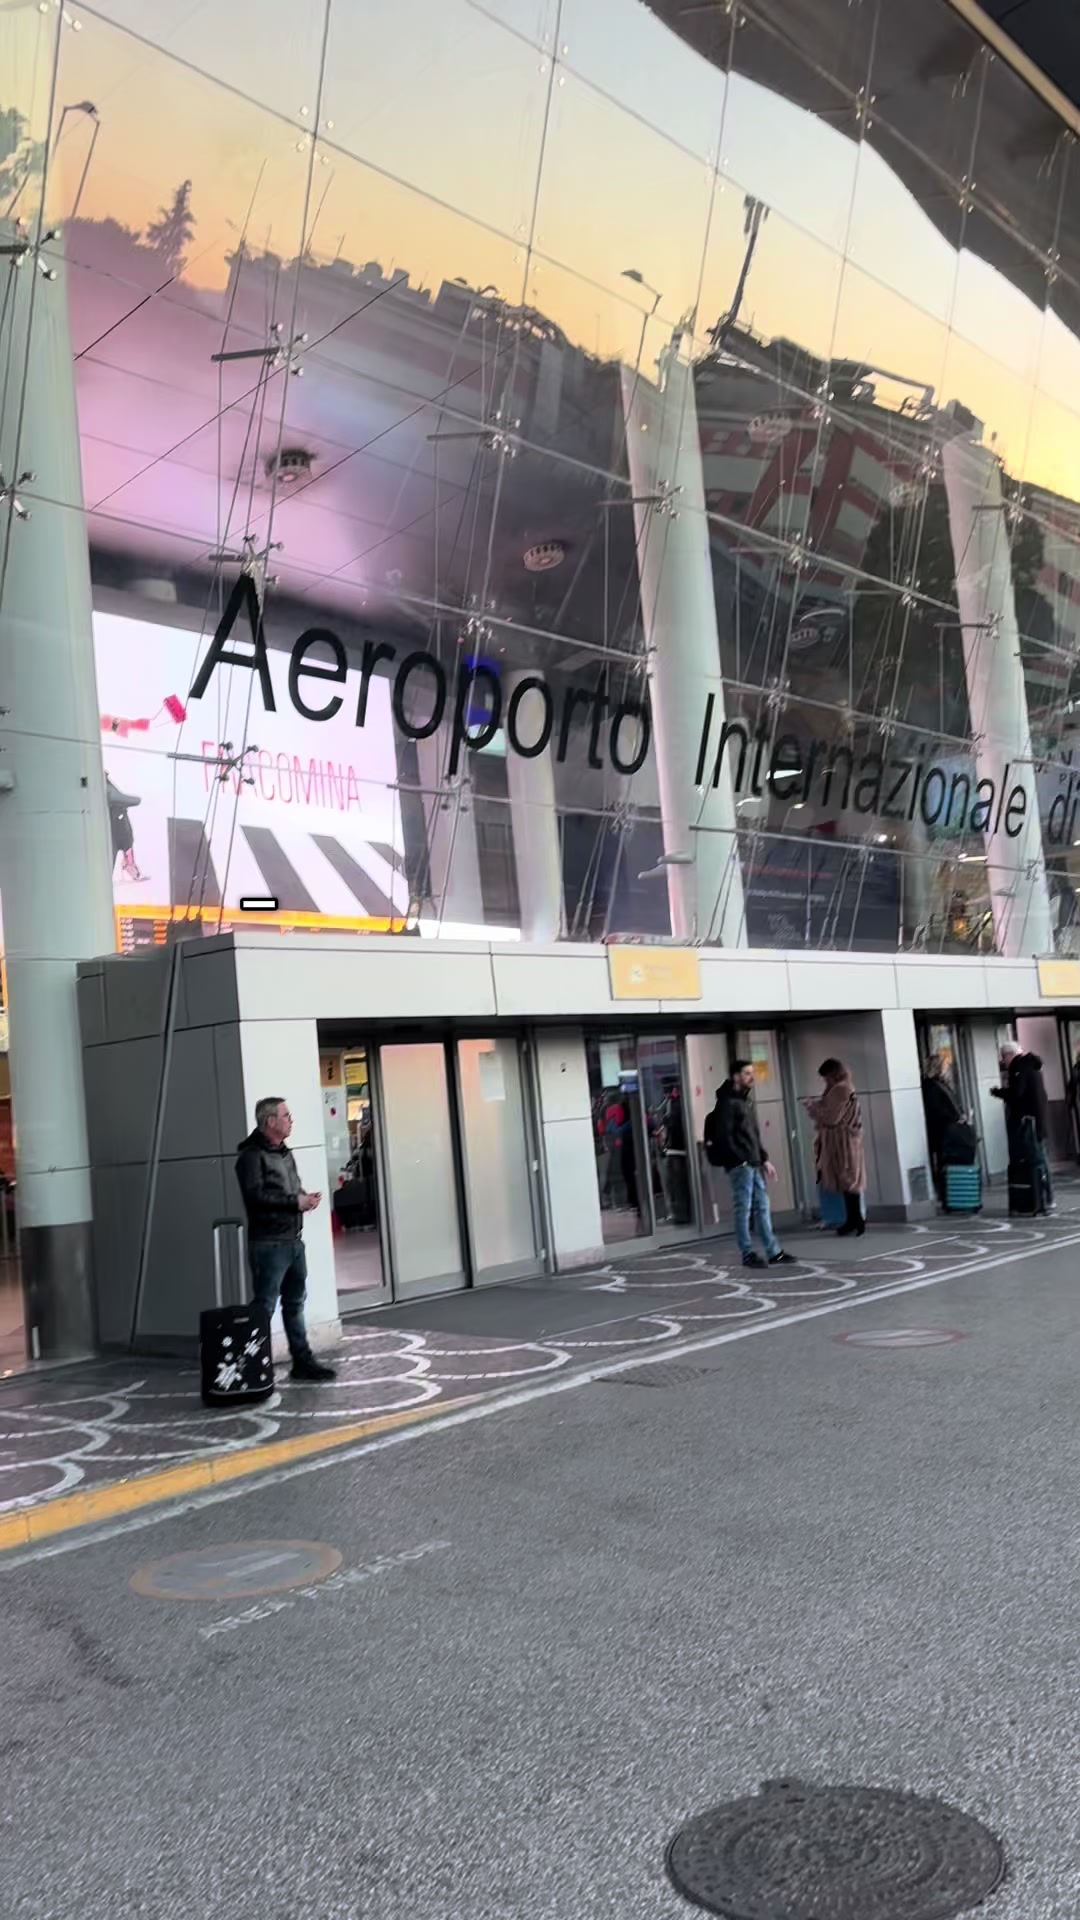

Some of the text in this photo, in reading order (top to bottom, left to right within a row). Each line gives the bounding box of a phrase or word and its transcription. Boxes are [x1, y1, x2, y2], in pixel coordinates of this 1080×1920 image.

[188, 574, 1080, 846] Aeroporto Internazionale di
